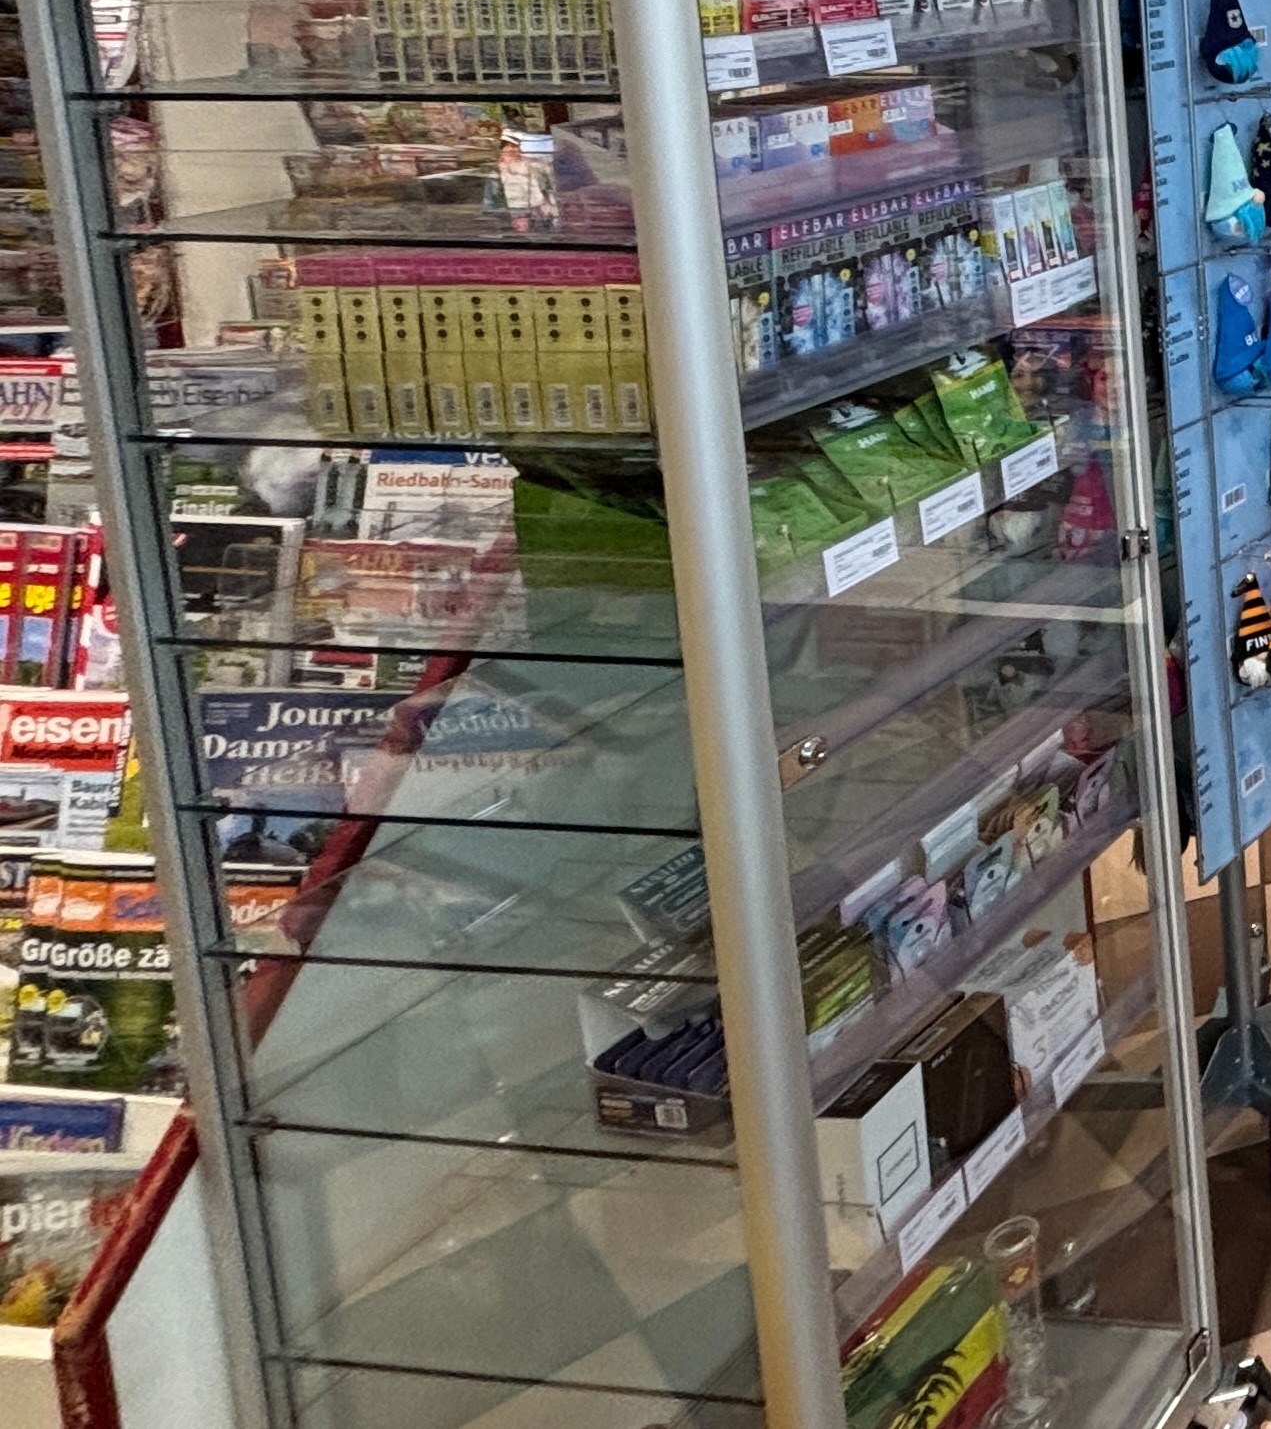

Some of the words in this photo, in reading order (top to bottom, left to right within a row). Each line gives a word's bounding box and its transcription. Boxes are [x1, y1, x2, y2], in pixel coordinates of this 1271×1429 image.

[851, 196, 909, 223] ELFBAR
[779, 212, 845, 241] ELFBAR
[782, 234, 845, 264] REFILLABLE
